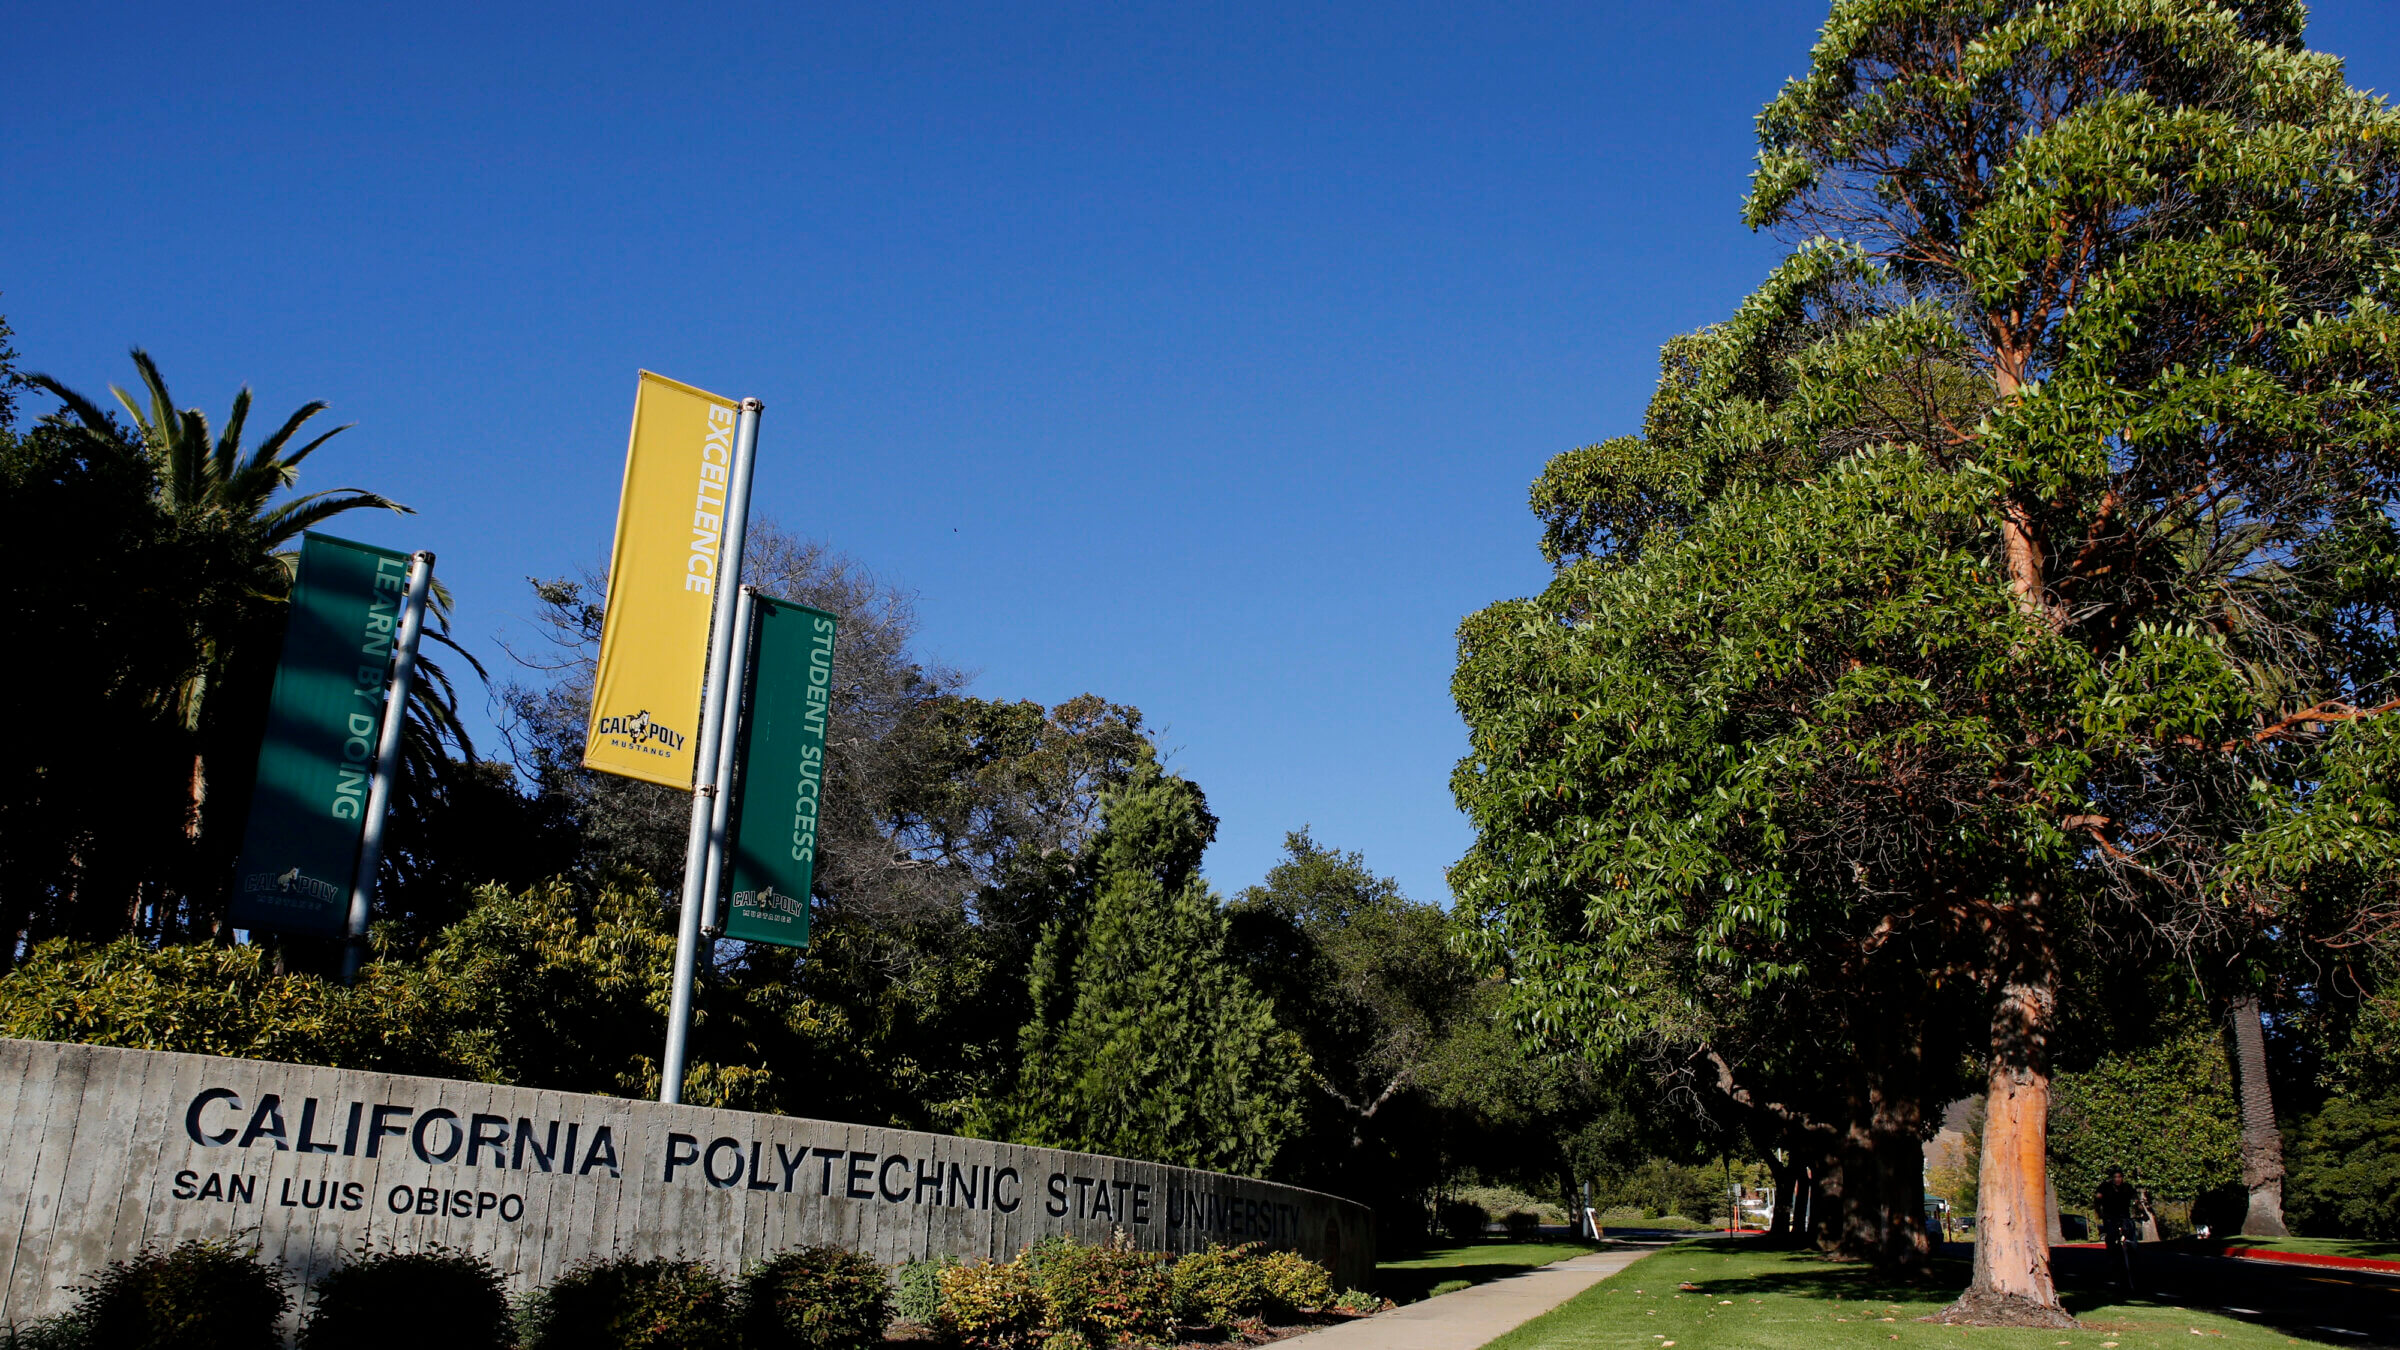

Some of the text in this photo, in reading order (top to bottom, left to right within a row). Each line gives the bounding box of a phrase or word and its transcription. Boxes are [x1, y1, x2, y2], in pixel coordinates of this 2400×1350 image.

[685, 403, 733, 595] EXCELLENCE
[331, 557, 404, 820] LEARN BY DOING
[600, 717, 684, 751] CAL POLY
[611, 739, 671, 758] MUSTANGS
[792, 617, 834, 863] STUDENT SUCCESS
[244, 873, 278, 893] CAL
[296, 875, 339, 903] POLY
[733, 890, 803, 917] CAL POLY
[185, 1087, 1301, 1240] CALIFORNIA POLYTECHNIC STATE UNIVERSITY
[172, 1169, 525, 1222] SAN LUIS OBISPO
